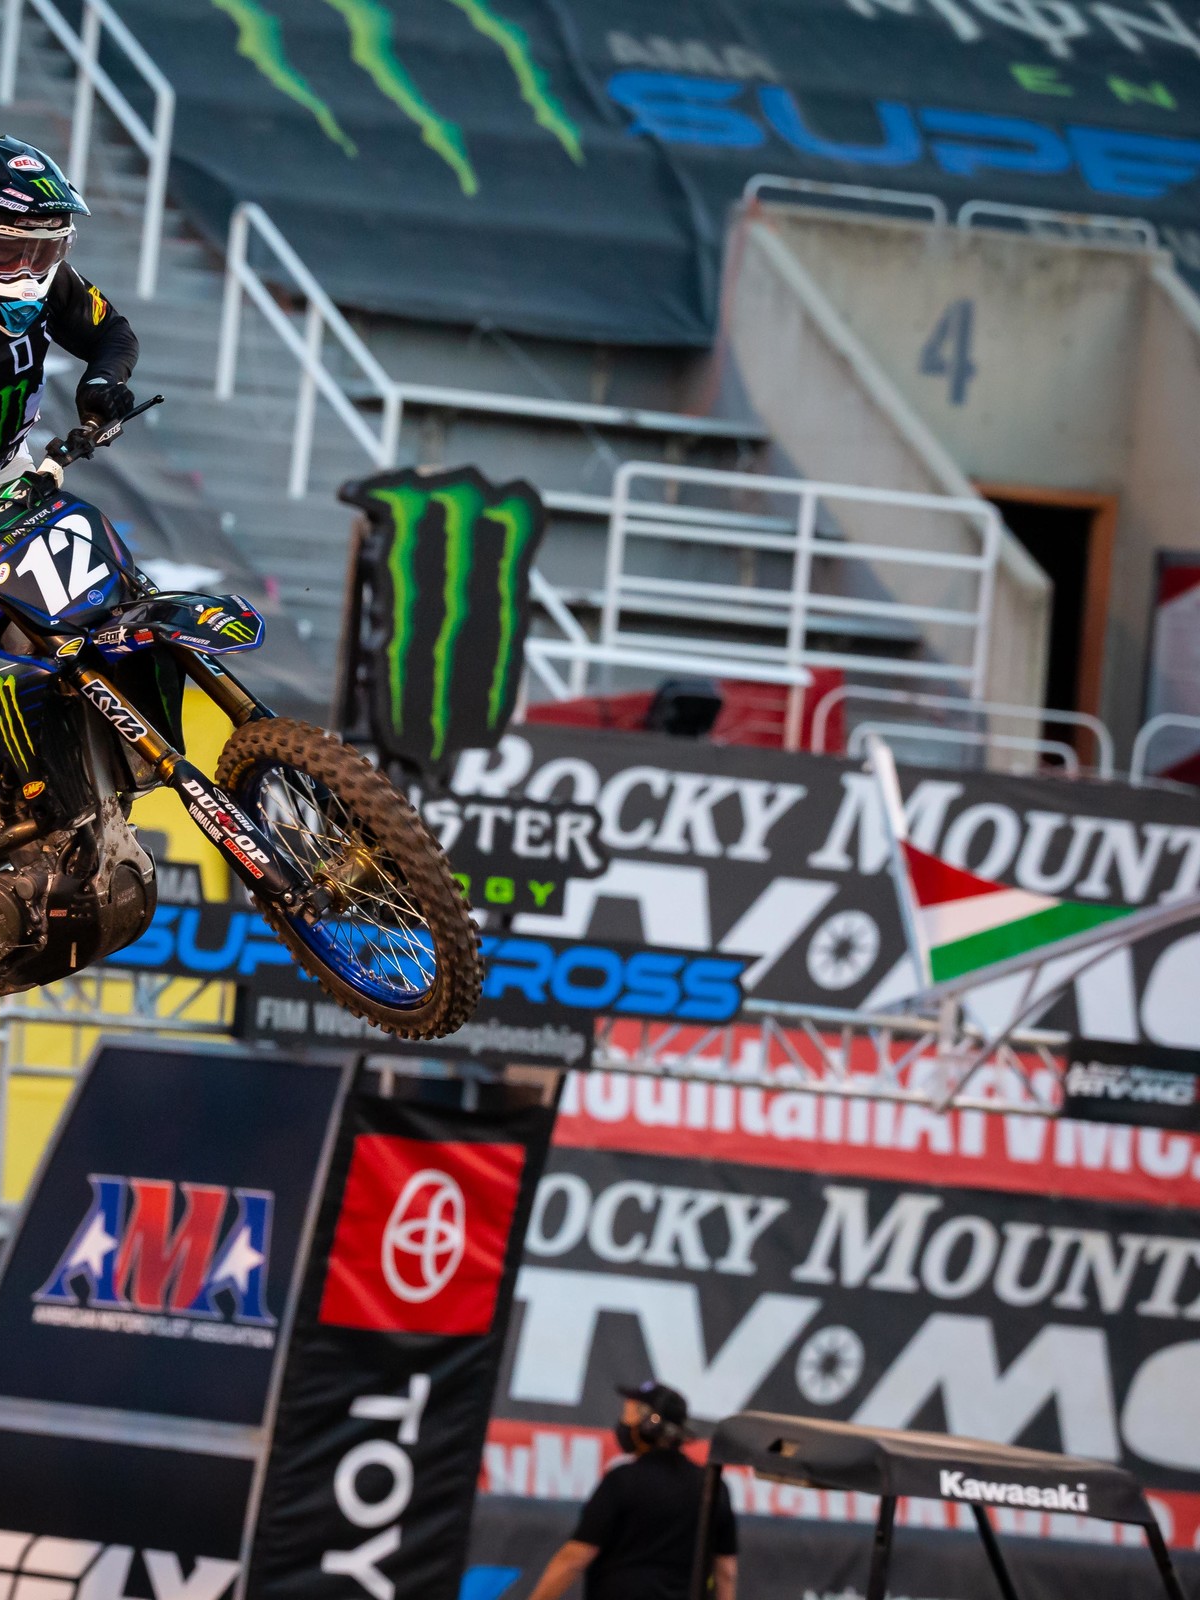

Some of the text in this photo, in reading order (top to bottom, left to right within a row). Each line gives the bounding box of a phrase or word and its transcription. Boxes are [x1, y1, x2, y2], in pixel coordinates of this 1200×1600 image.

[13, 158, 40, 169] BELL
[919, 298, 978, 407] 4
[10, 508, 51, 538] MNSTER
[15, 513, 110, 617] 12
[81, 678, 148, 743] KYB
[188, 802, 224, 843] YAMALUBE
[225, 802, 255, 832] CYCRA
[223, 838, 264, 879] BRAKING
[525, 1172, 789, 1277] OCKY
[30, 1172, 279, 1328] AMA
[939, 1470, 1089, 1513] Kawasaki
